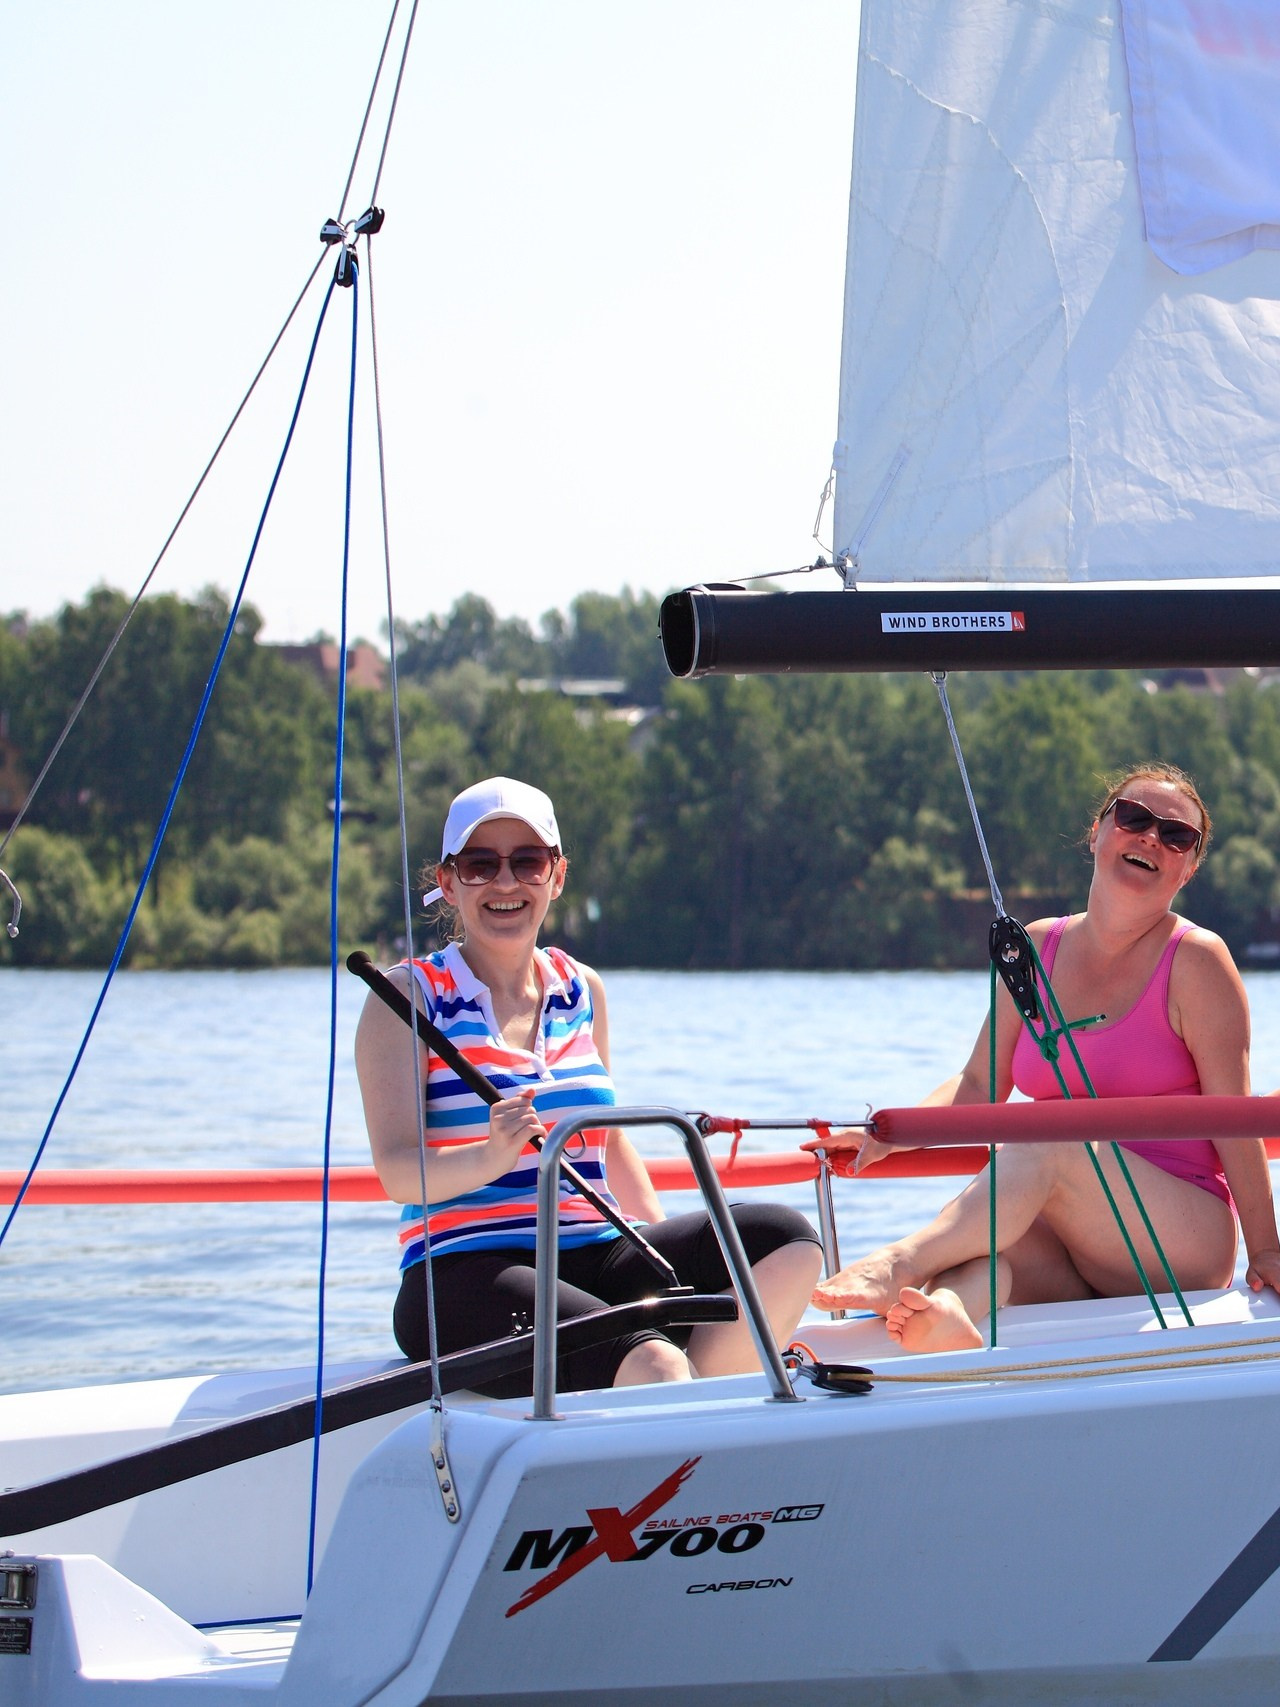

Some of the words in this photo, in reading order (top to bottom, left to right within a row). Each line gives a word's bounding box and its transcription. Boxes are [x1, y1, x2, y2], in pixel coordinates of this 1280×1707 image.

[889, 616, 927, 629] WIND
[932, 616, 1006, 628] BROTHERS
[645, 1515, 712, 1530] SAILING
[716, 1511, 774, 1525] BOATS
[776, 1506, 821, 1521] MG
[686, 1577, 794, 1595] CARBON
